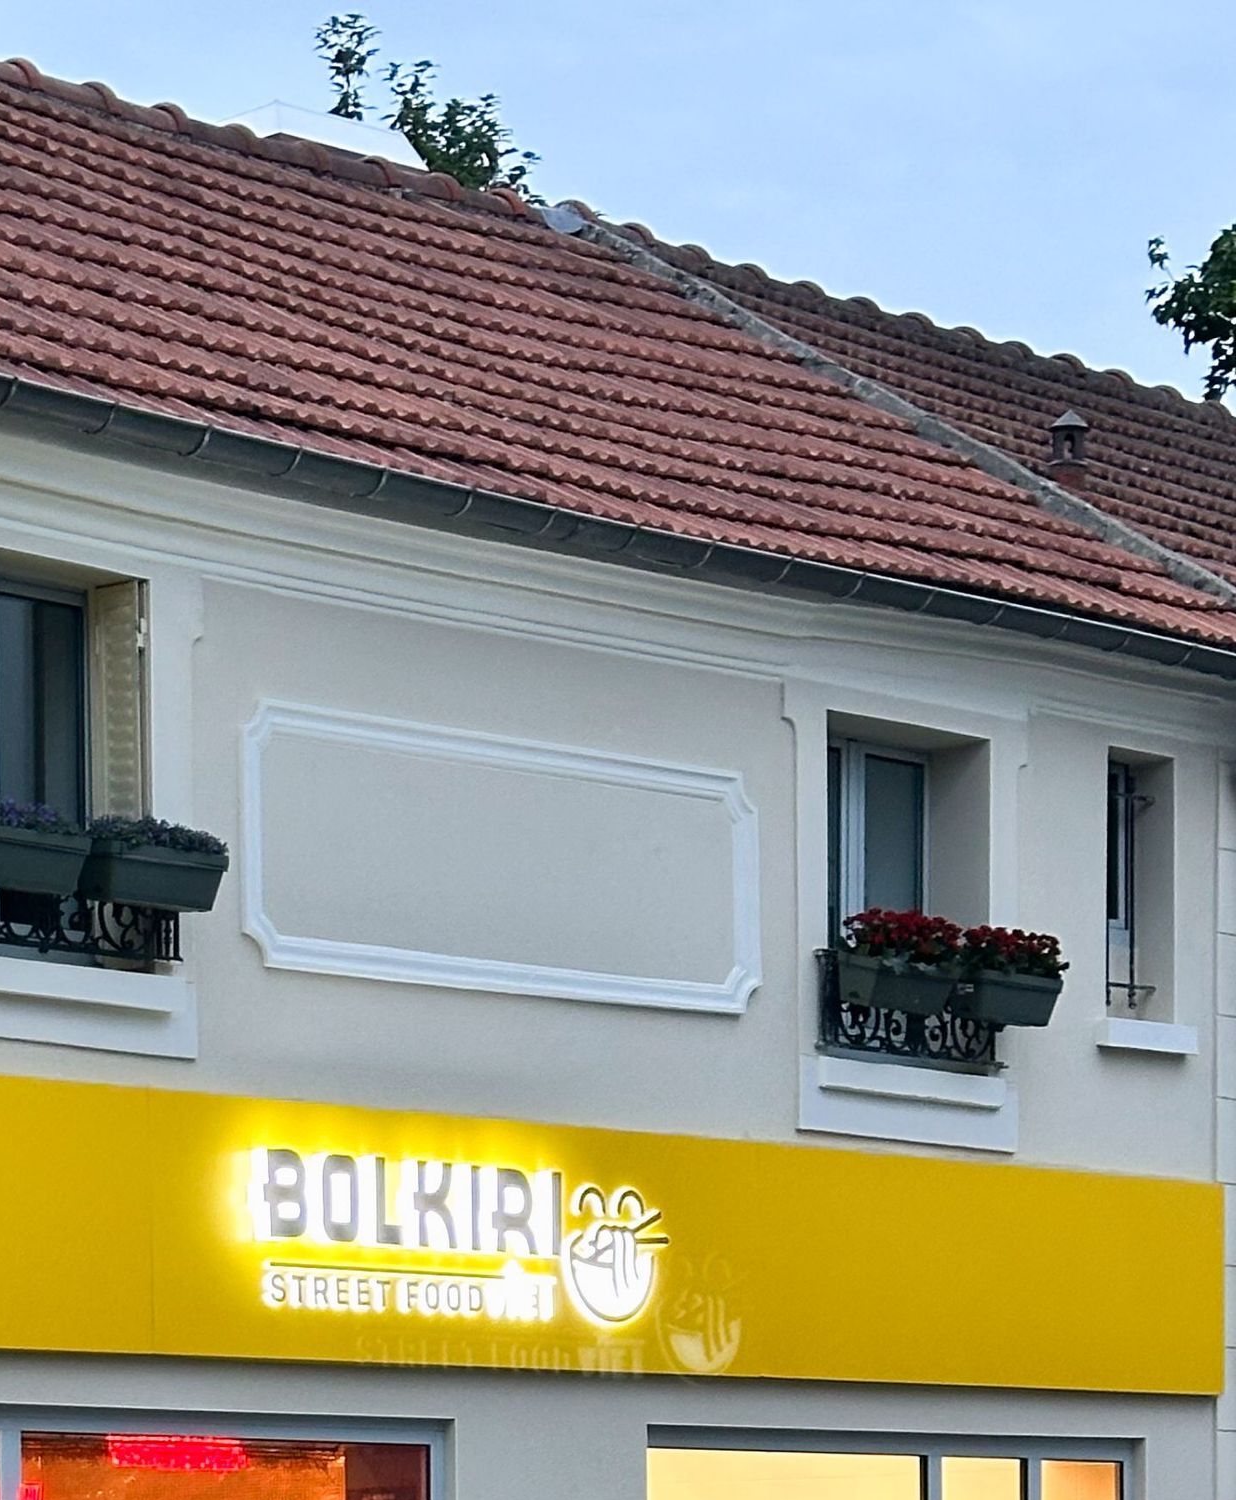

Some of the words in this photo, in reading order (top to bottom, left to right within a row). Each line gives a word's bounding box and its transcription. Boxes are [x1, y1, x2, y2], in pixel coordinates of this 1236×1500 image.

[256, 1147, 563, 1257] BOLKIRI
[269, 1274, 392, 1310] STREET
[406, 1281, 483, 1314] FOOD
